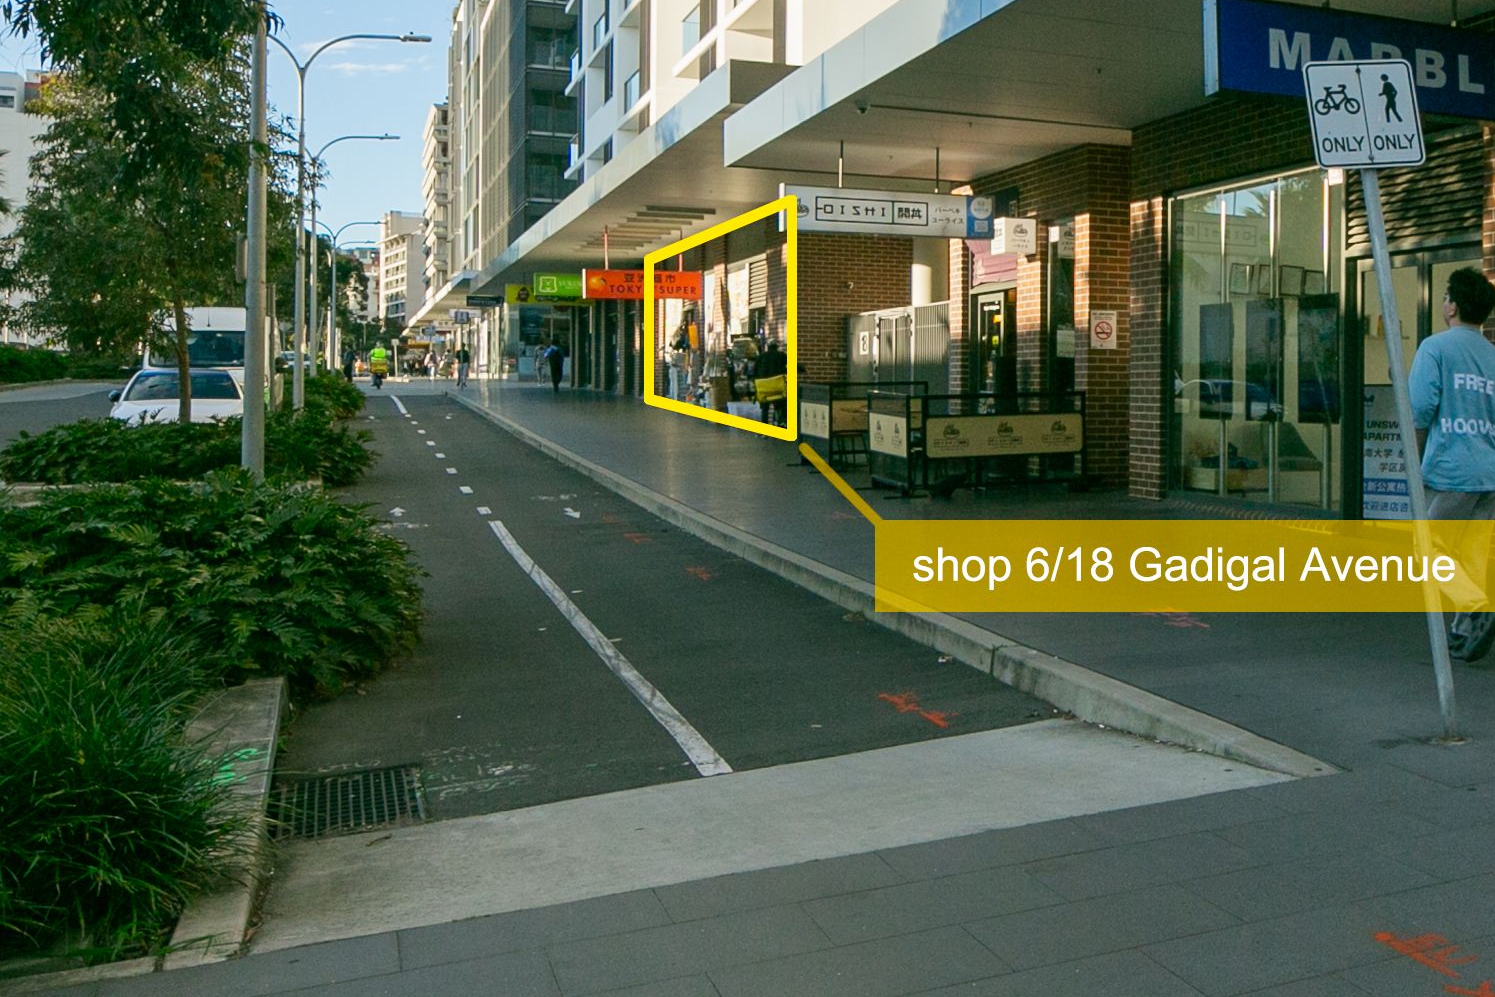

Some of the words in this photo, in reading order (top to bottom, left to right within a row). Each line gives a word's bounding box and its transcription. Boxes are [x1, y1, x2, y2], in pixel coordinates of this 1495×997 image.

[1322, 134, 1366, 153] ONLY
[1373, 132, 1417, 151] ONLY
[608, 284, 648, 294] TOKY
[659, 286, 697, 295] SUPER
[1453, 372, 1495, 395] FREE
[1366, 420, 1400, 429] UNSW
